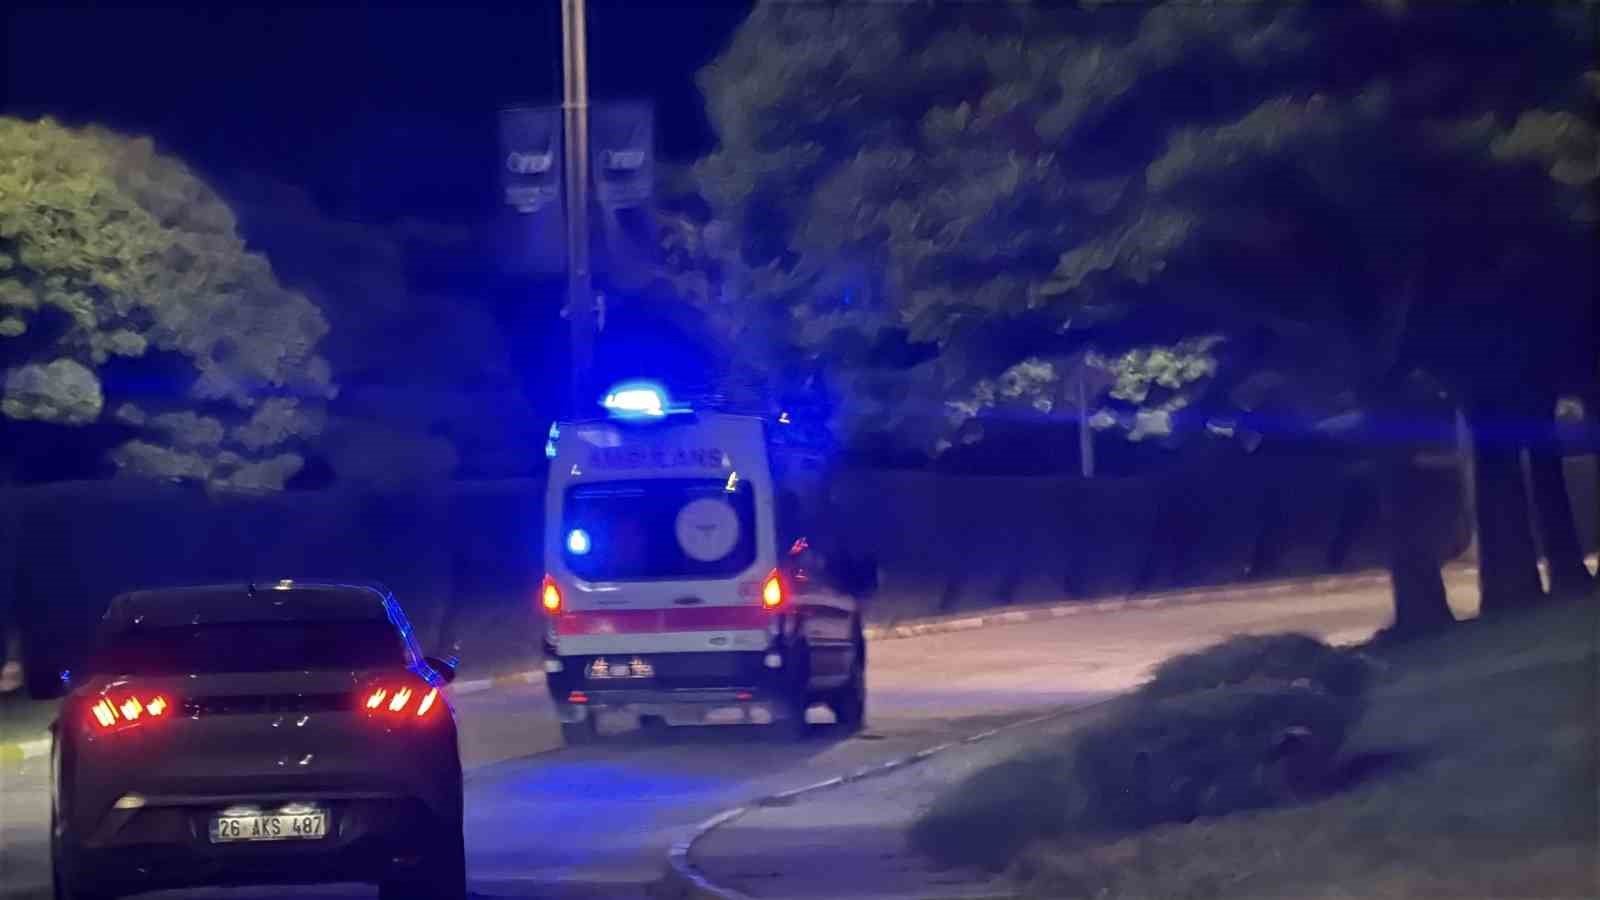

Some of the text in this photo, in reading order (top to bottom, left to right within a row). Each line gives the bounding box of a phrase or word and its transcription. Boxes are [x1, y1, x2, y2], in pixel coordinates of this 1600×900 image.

[220, 816, 322, 837] 26 AKS 487
